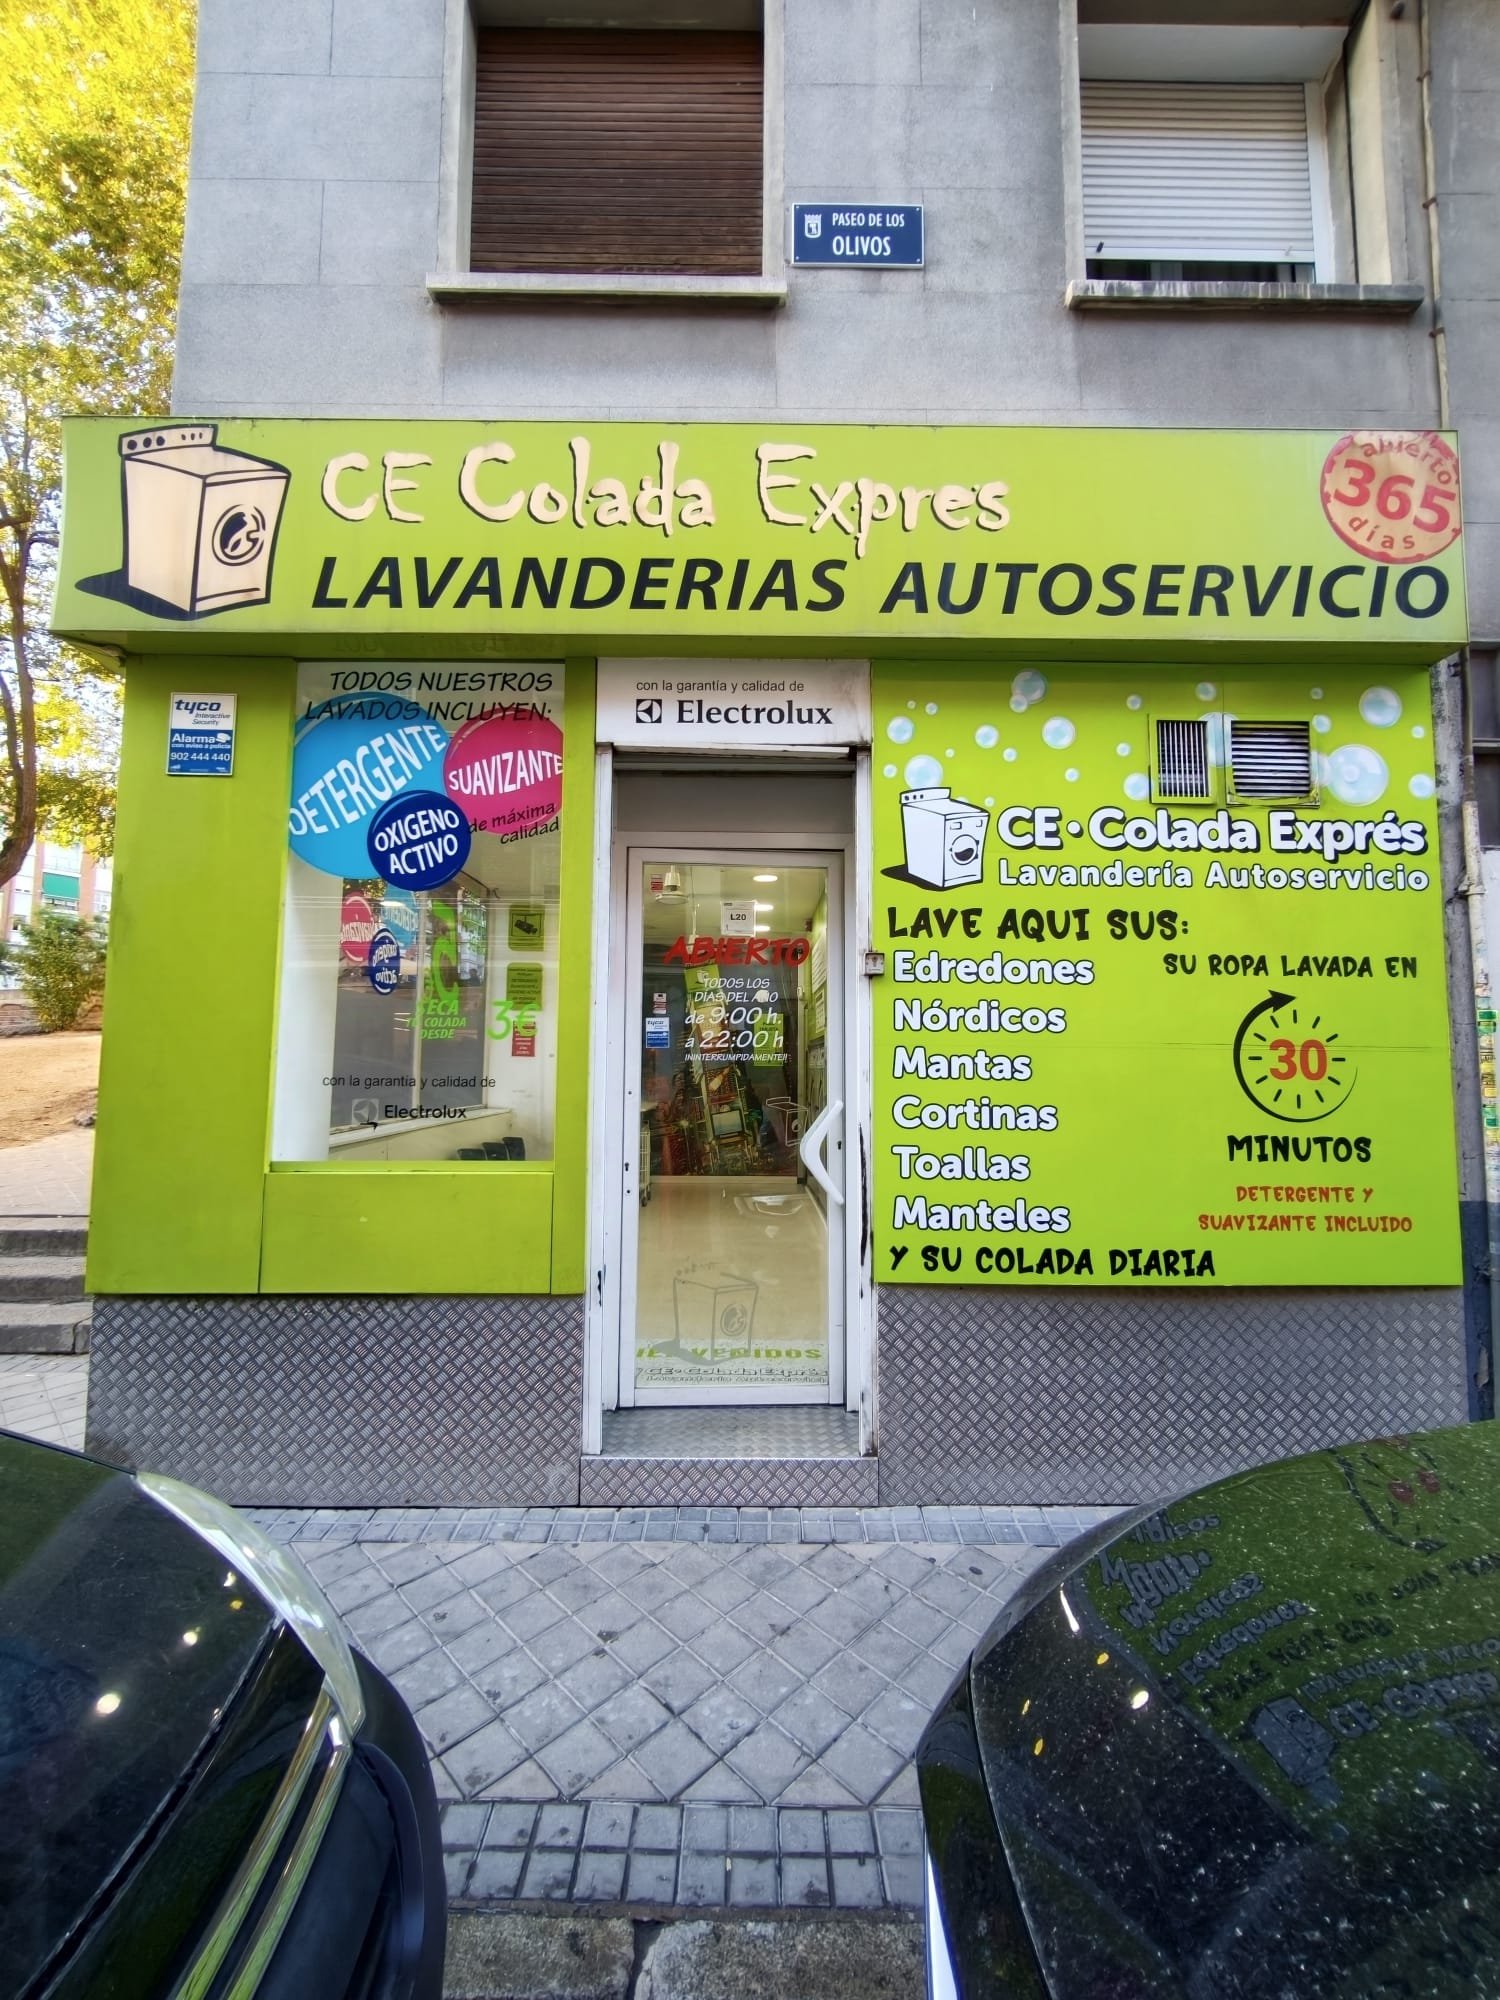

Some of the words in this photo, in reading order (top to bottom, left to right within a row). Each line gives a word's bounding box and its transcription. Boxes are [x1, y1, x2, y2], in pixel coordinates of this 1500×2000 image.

[832, 212, 865, 227] PASEO
[868, 213, 882, 227] DE
[886, 214, 905, 228] LOS
[832, 235, 891, 257] OLIVOS
[321, 451, 434, 523] CE
[458, 436, 716, 538] Colada
[755, 442, 1011, 560] Expres
[1333, 458, 1457, 534] 365
[312, 557, 847, 612] LAVANDERIAS
[879, 562, 1449, 619] AUTOSERVICIO
[330, 671, 412, 691] TODOS
[417, 672, 553, 692] NUESTROS
[636, 681, 658, 691] con
[662, 680, 673, 691] la
[676, 680, 727, 694] garantía
[731, 682, 738, 694] y
[742, 680, 785, 692] calidad
[789, 680, 804, 692] de
[175, 699, 221, 715] tyco
[194, 711, 231, 720] Interactive
[305, 701, 420, 721] LAVADOS
[426, 702, 552, 722] INCLUYEN:
[676, 699, 833, 725] Electrolux
[191, 718, 220, 727] Security
[172, 732, 216, 744] Alarma
[170, 752, 189, 761] 902
[190, 752, 209, 761] 444
[211, 753, 231, 762] 440
[288, 725, 447, 835] DETERGENTE
[448, 749, 563, 796] SUAVIZANTE
[374, 809, 460, 852] OXIGENO
[468, 817, 488, 835] de
[492, 802, 556, 829] máxima
[500, 816, 560, 845] calidad
[1267, 809, 1429, 863] Exprés
[389, 834, 459, 875] ACTIVO
[999, 857, 1193, 889] Lavandería
[1204, 861, 1430, 892] Autoservicio
[730, 912, 747, 921] L20
[887, 907, 983, 940] LAVE
[997, 908, 1090, 943] AQUI
[1107, 909, 1190, 942] SUS:
[662, 935, 811, 966] ABIERTO
[892, 948, 1096, 986] Edredones
[1163, 954, 1197, 977] SU
[1209, 954, 1269, 977] ROPA
[1281, 956, 1373, 979] LAVADA
[1385, 957, 1418, 980] EN
[704, 977, 744, 989] TODOS
[746, 977, 770, 989] LOS
[727, 991, 749, 1003] DEL
[751, 990, 779, 1003] AO
[424, 1016, 467, 1028] COLADA
[486, 1000, 539, 1041] 3€
[684, 1010, 705, 1025] de
[708, 1006, 762, 1025] 9:00
[892, 998, 1067, 1036] Nórdicos
[420, 1028, 456, 1040] DESDE
[684, 1037, 694, 1048] a
[699, 1030, 768, 1048] 22:00
[772, 1030, 784, 1048] h
[892, 1045, 1033, 1083] Mantas
[1268, 1038, 1328, 1082] 30
[322, 1076, 345, 1087] con
[350, 1075, 360, 1087] la
[420, 1078, 428, 1090] y
[431, 1076, 476, 1088] calidad
[480, 1076, 496, 1088] de
[384, 1104, 467, 1119] Electrolux
[891, 1094, 1060, 1133] Cortinas
[1227, 1134, 1373, 1164] MINUTOS
[891, 1144, 1031, 1183] Toallas
[1236, 1186, 1355, 1203] DETERGENTE
[1362, 1186, 1374, 1203] Y
[892, 1195, 1072, 1234] Manteles
[1198, 1213, 1316, 1232] SUAVIZANTE
[1325, 1214, 1413, 1233] INCLUIDO
[889, 1245, 908, 1271] Y
[921, 1245, 962, 1272] SU
[976, 1247, 1094, 1276] COLADA
[1109, 1249, 1216, 1278] DIARIA
